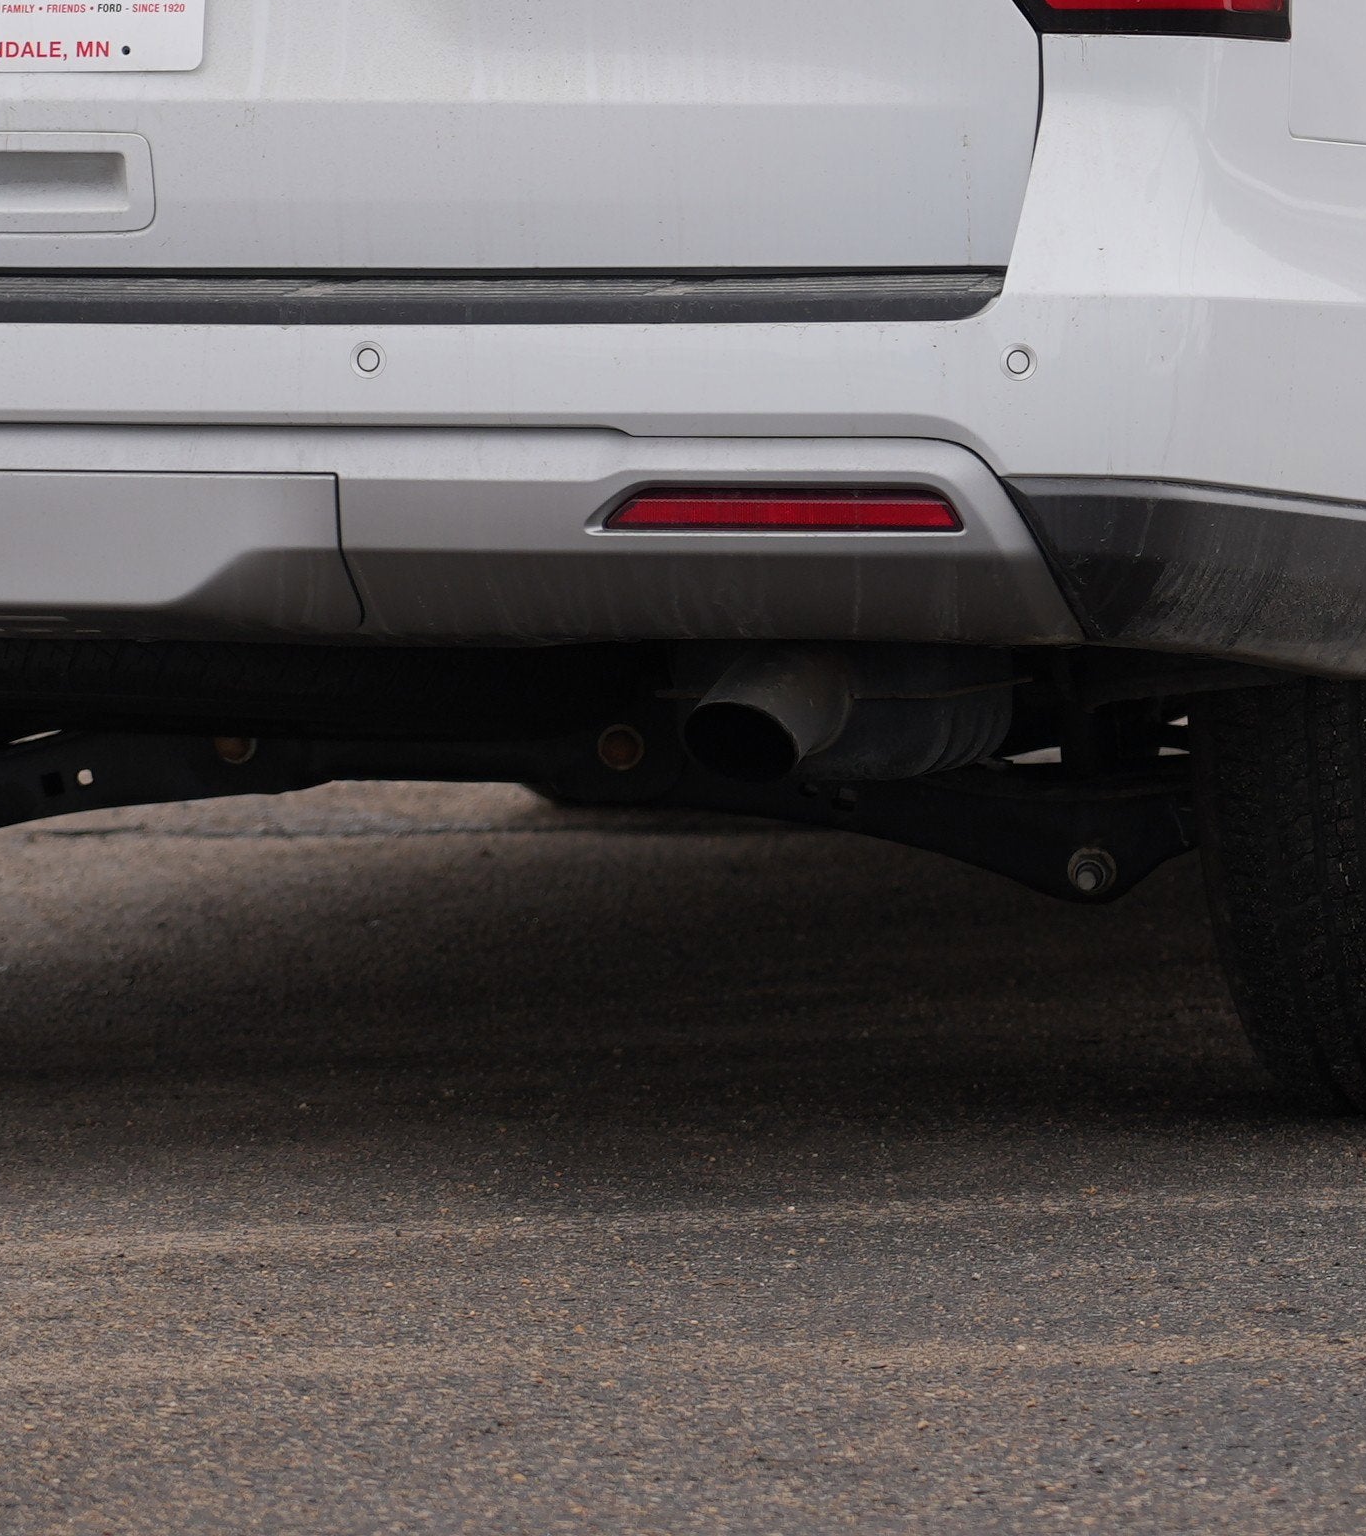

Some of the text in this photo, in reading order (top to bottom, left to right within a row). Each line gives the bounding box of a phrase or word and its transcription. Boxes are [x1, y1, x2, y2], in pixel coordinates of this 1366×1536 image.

[1, 4, 35, 14] FAMILY
[46, 3, 86, 14] FRIENDS
[97, 3, 122, 13] FORD
[132, 3, 160, 13] SINCE
[163, 3, 185, 13] 1920
[76, 41, 110, 58] MN
